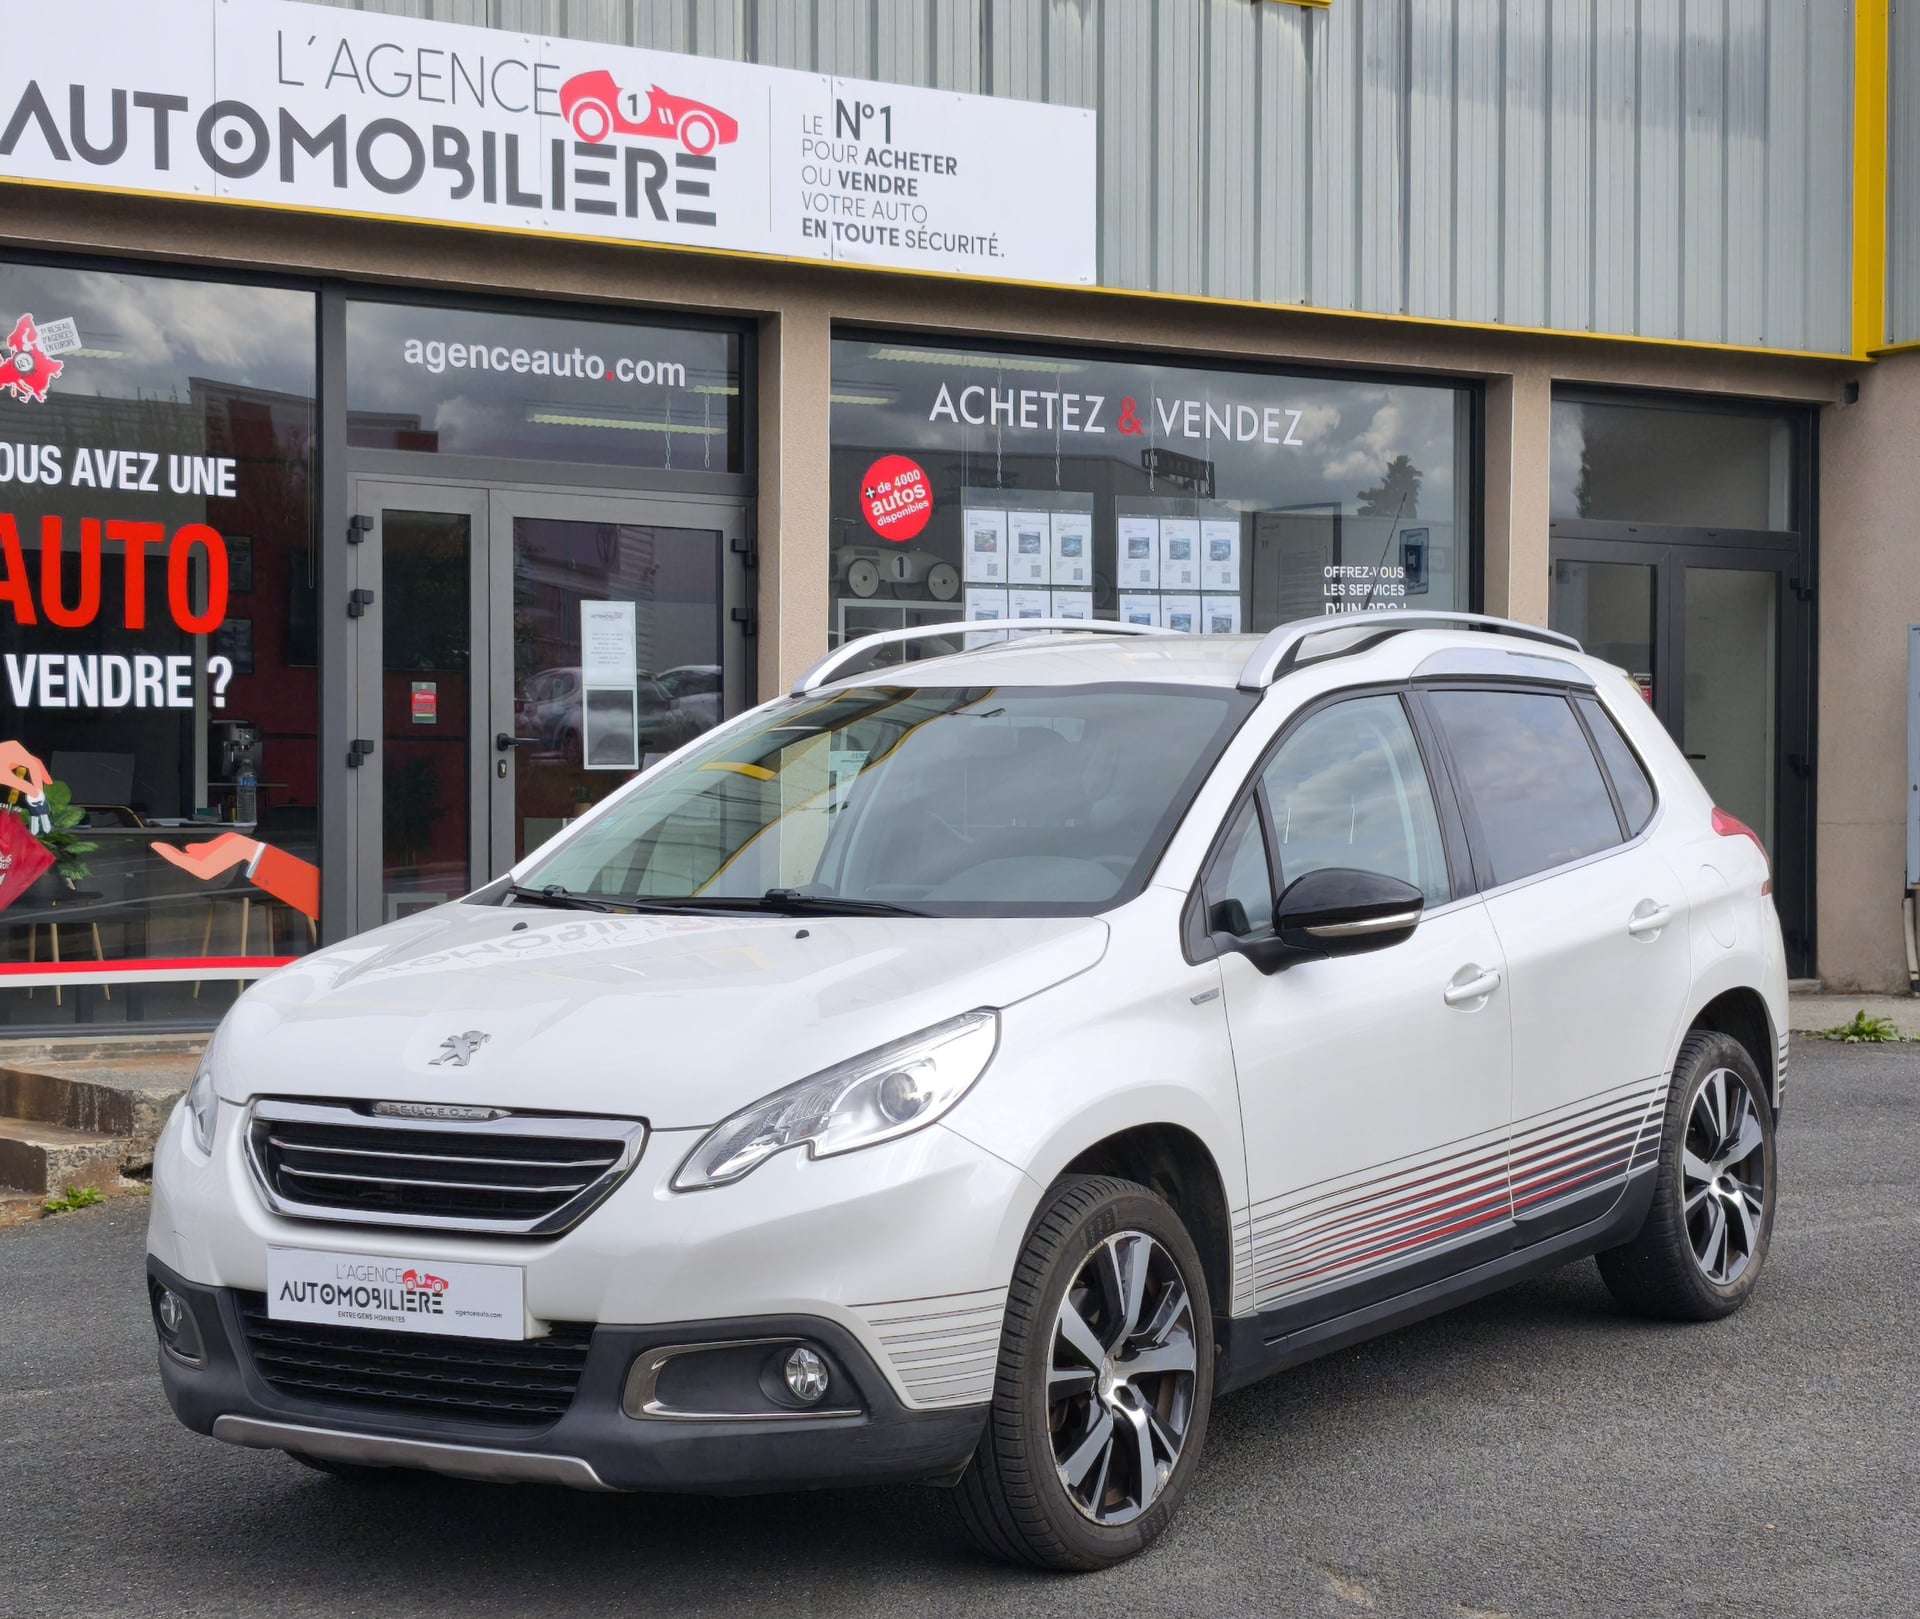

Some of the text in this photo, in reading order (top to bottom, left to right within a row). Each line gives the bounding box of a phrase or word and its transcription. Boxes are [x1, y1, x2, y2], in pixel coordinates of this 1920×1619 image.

[278, 30, 562, 117] L'AGENCE
[802, 114, 823, 136] LE
[0, 79, 717, 227] AUTOMOBILIERE
[802, 138, 957, 176] POUR ACHETER
[802, 165, 918, 197] OU VENDRE
[801, 191, 928, 224] VOTRE AUTO
[802, 217, 1005, 257] EN TOUTE SÉCURITÉ.
[404, 338, 686, 387] agenceauto.com
[929, 382, 1303, 446] ACHETEZ & VENDEZ
[71, 447, 159, 492] AVEZ
[169, 454, 237, 498] UNE
[877, 482, 892, 494] de
[894, 469, 921, 487] 4000
[871, 484, 926, 516] autos
[877, 500, 929, 526] disponibles
[1323, 566, 1405, 578] OFFREZ-VOUS
[1323, 583, 1406, 597] LES SERVICES
[5, 654, 234, 708] VENDRE ?
[389, 1104, 473, 1117] PEUGEOT
[335, 1263, 403, 1285] L'AGENCE
[280, 1280, 443, 1315] AUTOMOBILIERE
[337, 1310, 357, 1319] ENTRE
[356, 1312, 373, 1321] GENS
